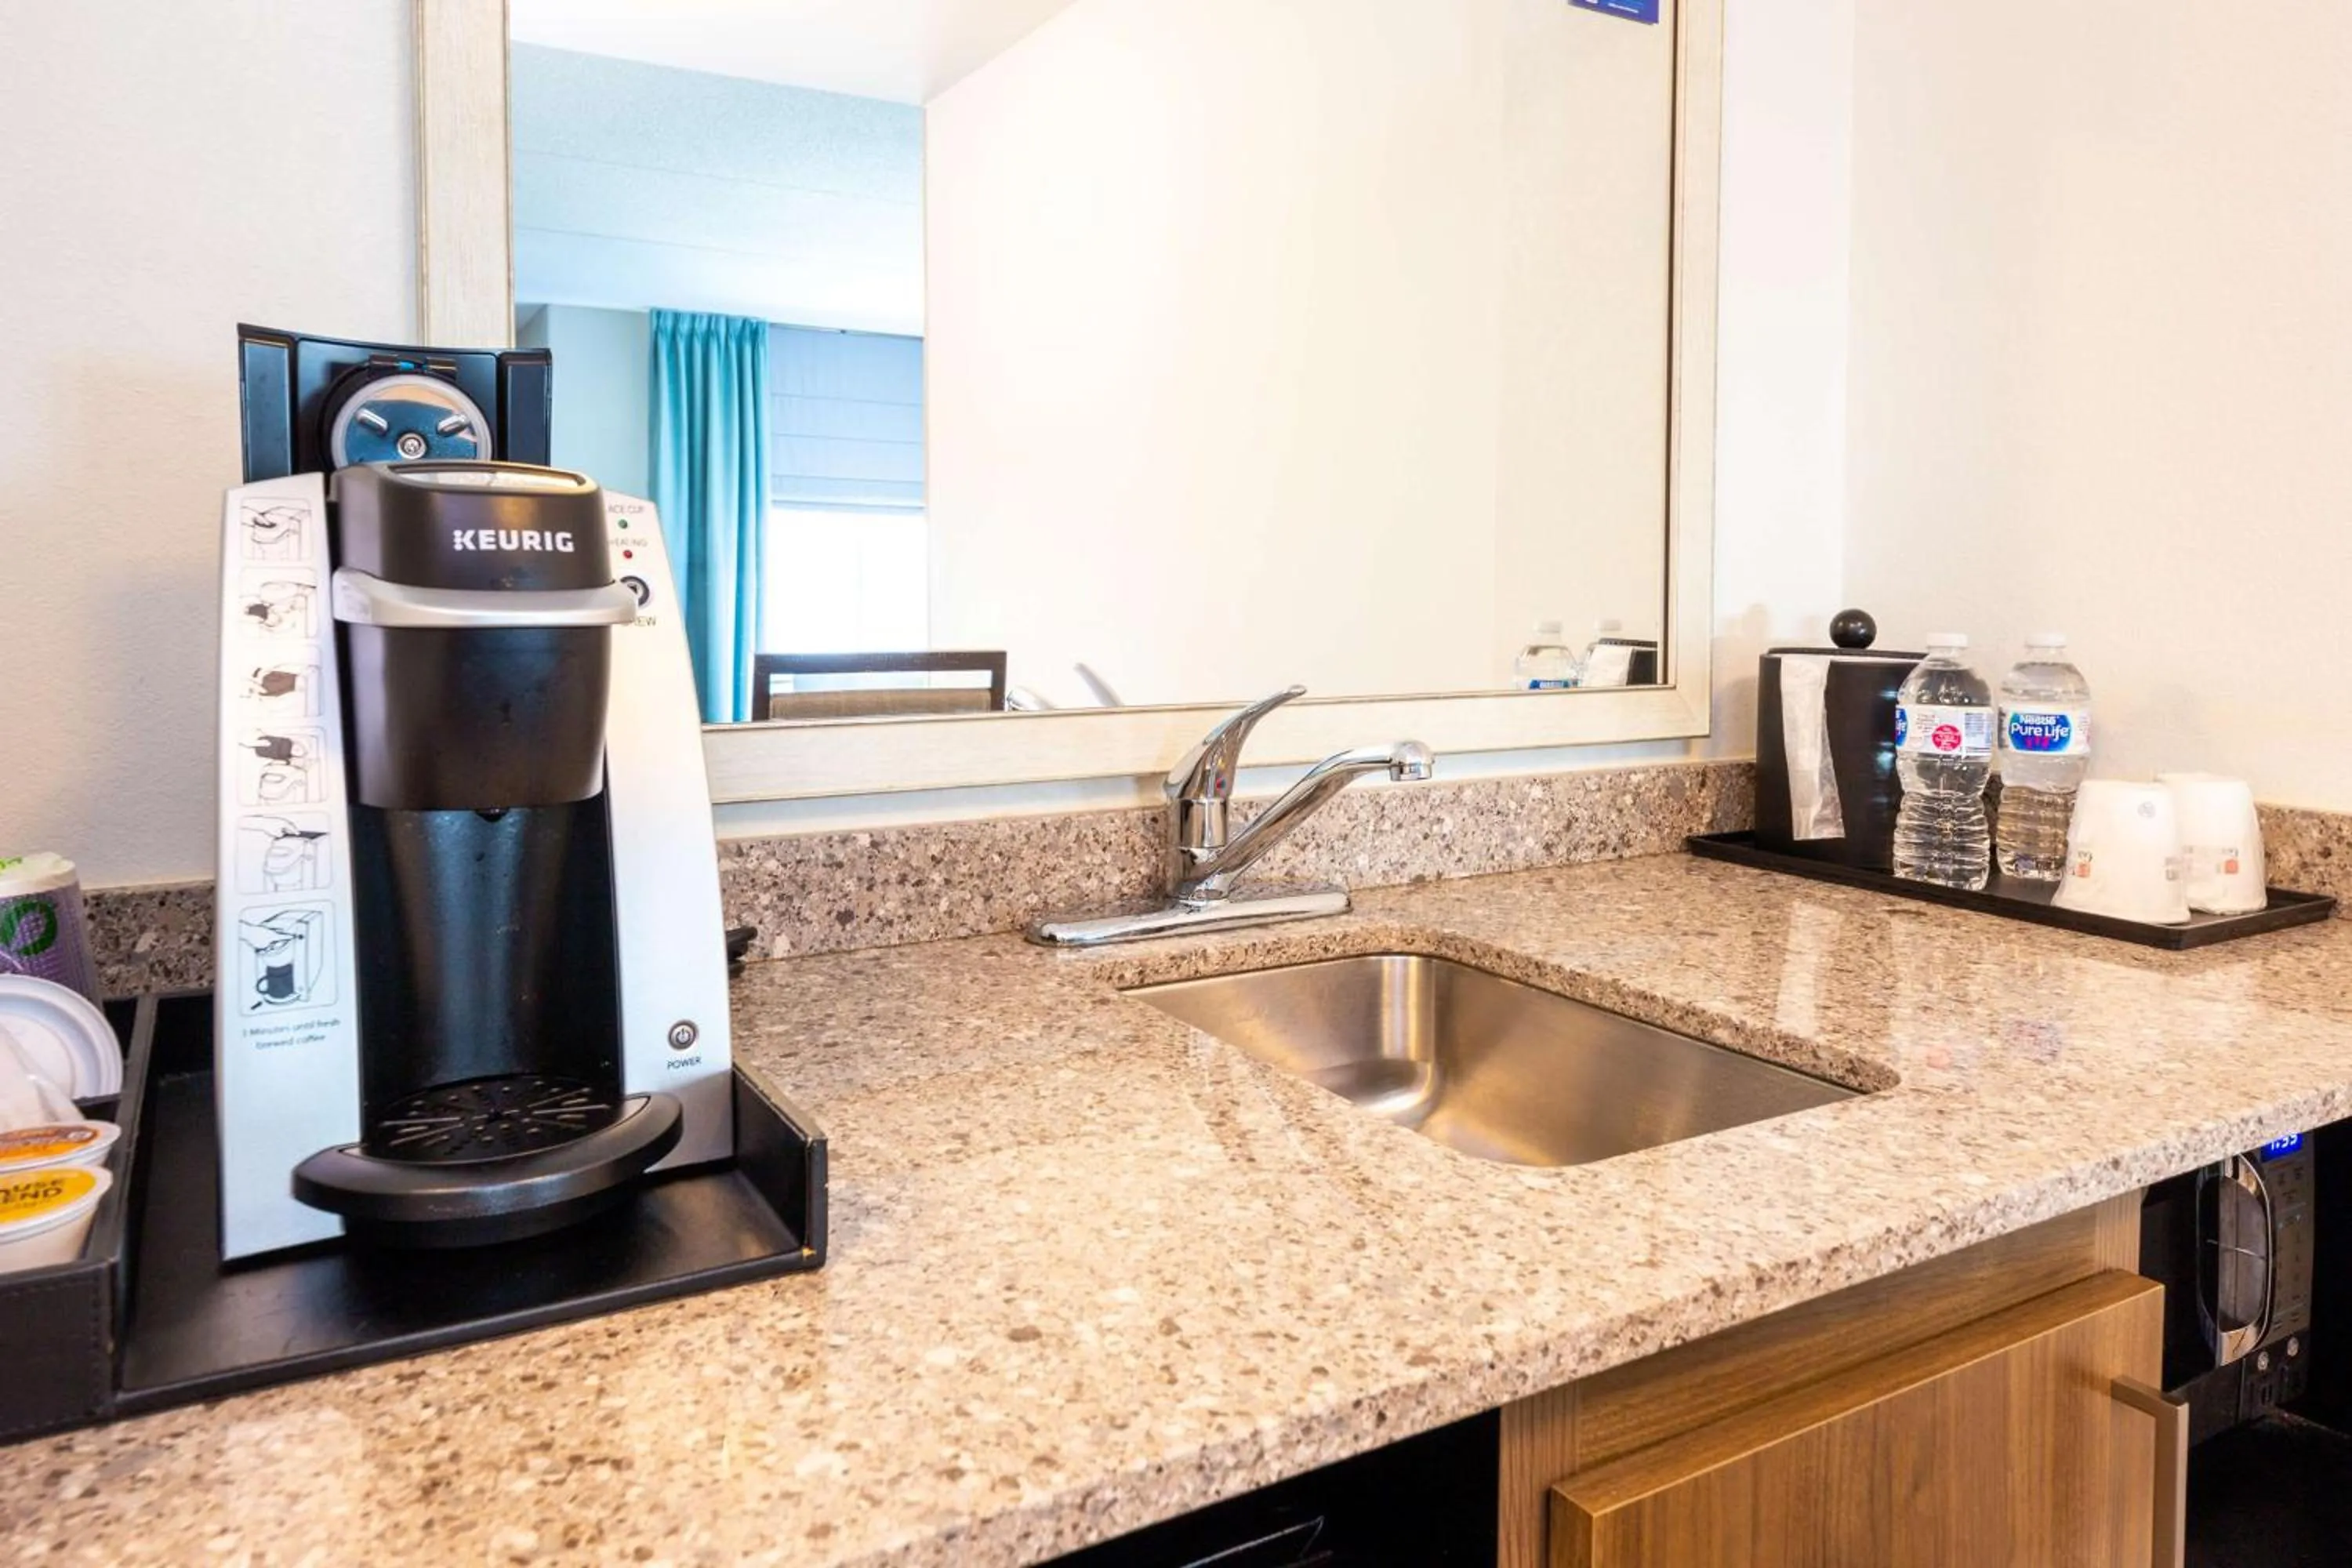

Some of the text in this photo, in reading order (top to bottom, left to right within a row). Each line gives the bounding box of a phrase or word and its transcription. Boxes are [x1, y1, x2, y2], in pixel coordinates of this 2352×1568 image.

[452, 529, 575, 553] KEURIG
[2011, 722, 2043, 736] Pure
[2044, 724, 2070, 742] Life
[666, 1056, 702, 1070] POWER
